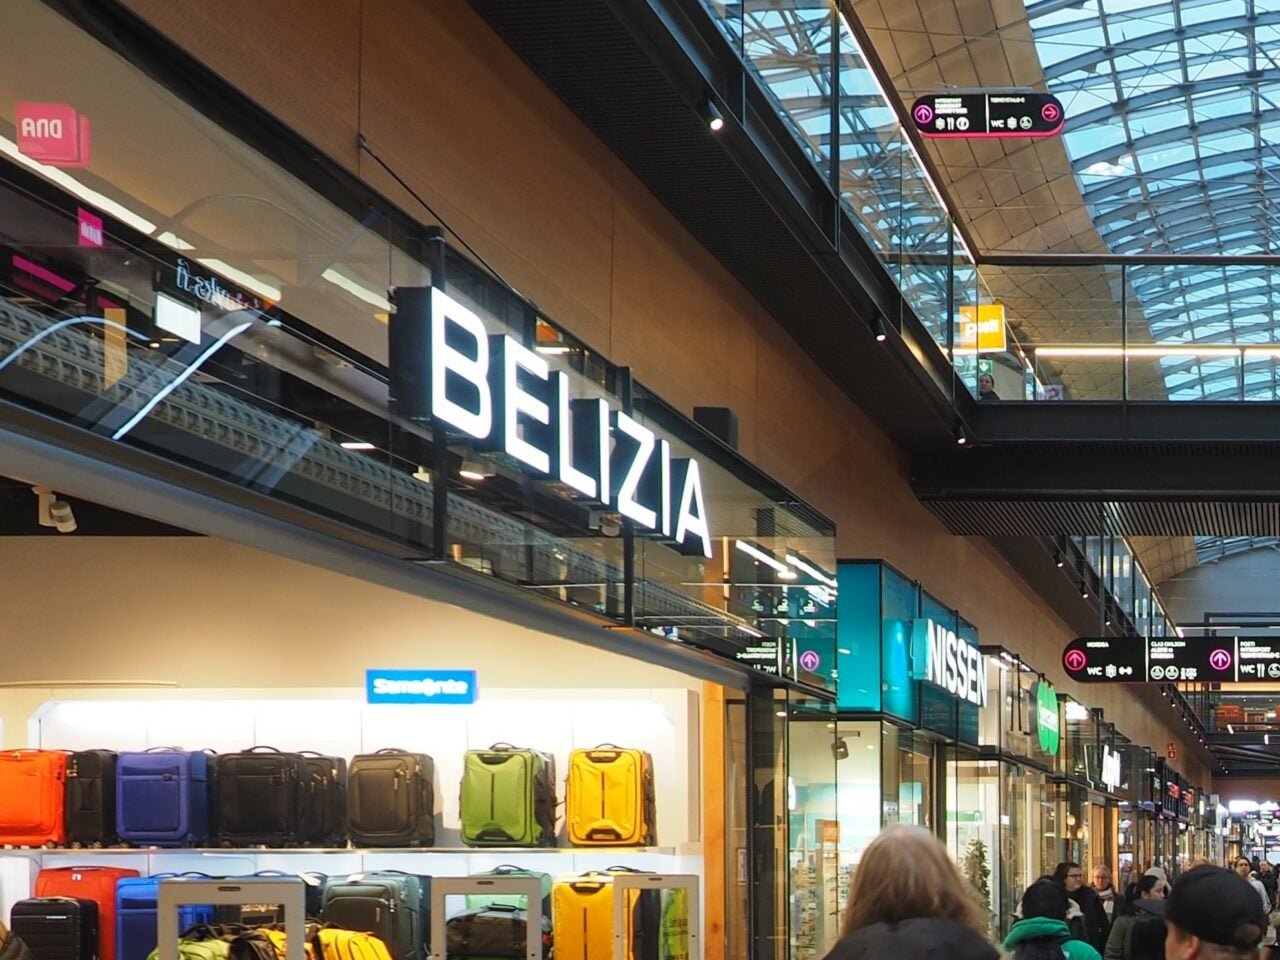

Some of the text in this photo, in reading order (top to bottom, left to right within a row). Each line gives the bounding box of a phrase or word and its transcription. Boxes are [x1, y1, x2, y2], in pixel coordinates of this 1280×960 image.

[991, 119, 1004, 127] WC
[431, 286, 712, 558] BELIZIA
[928, 619, 988, 708] NISSEN
[1087, 666, 1103, 676] WC
[1240, 664, 1255, 674] WC
